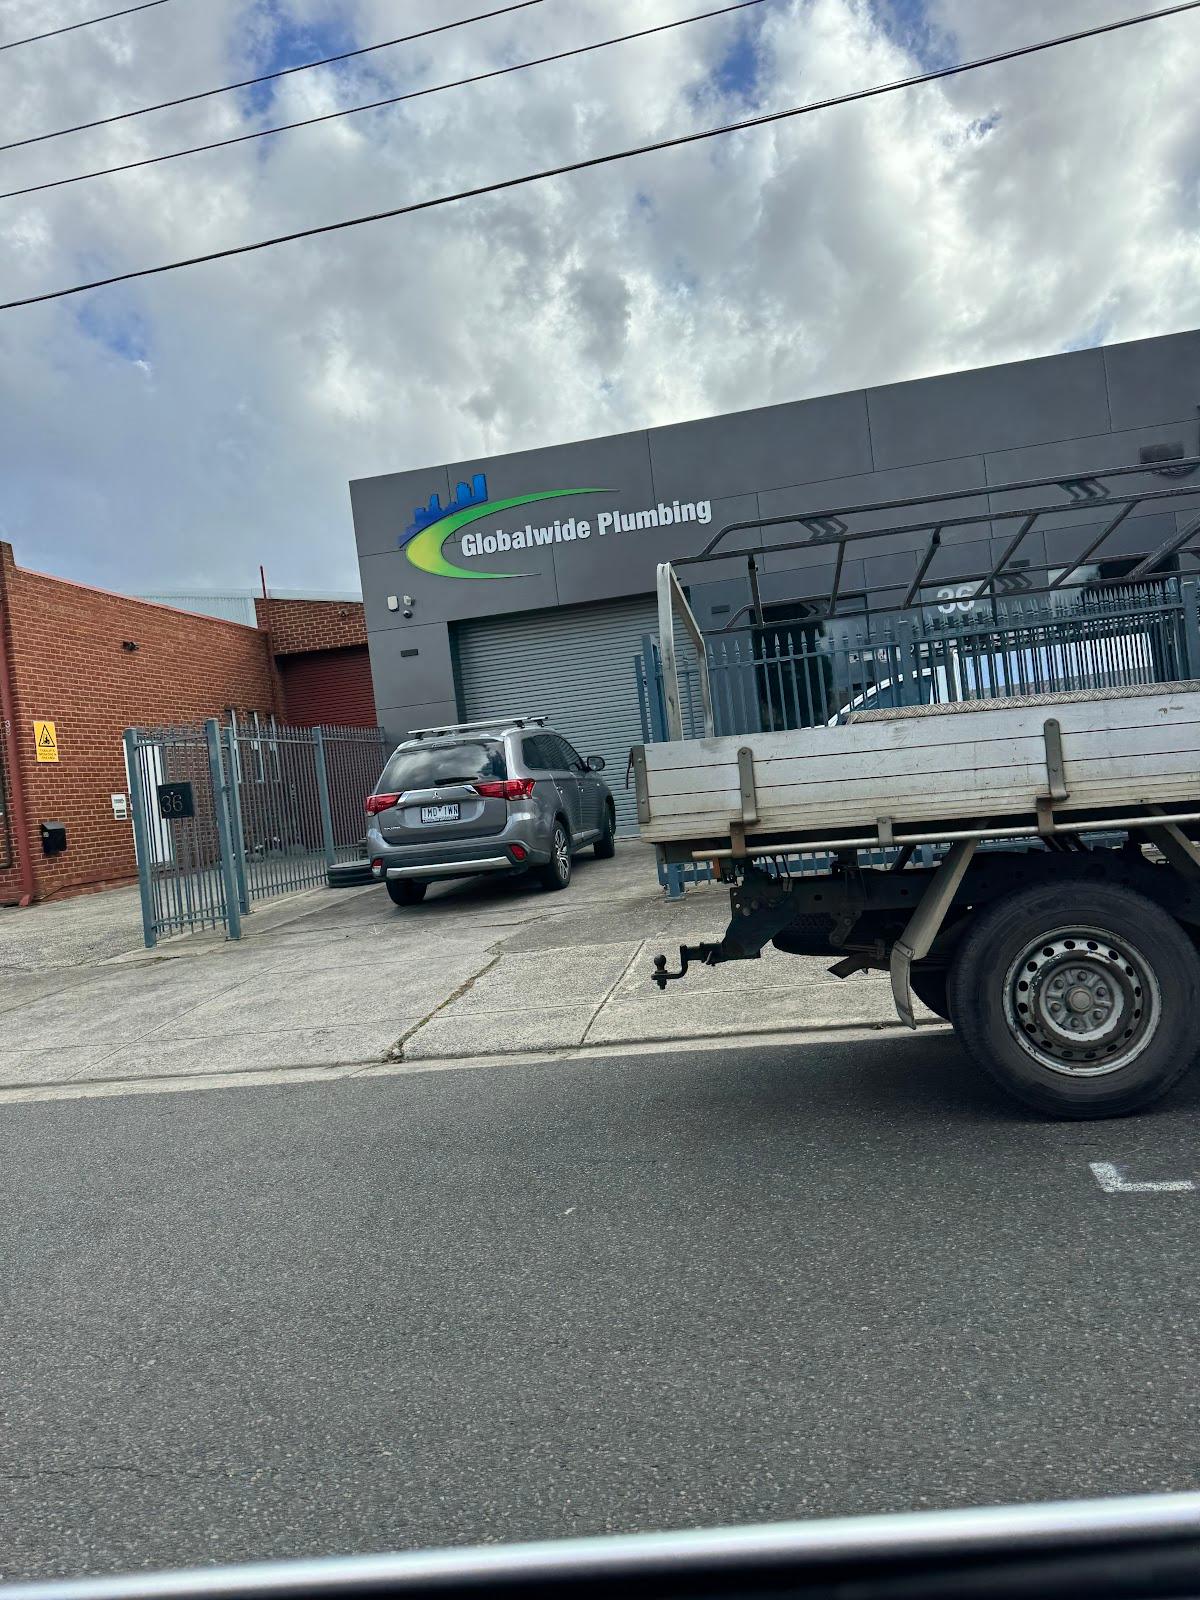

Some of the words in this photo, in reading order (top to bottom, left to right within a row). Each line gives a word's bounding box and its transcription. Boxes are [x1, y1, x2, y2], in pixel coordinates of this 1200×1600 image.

[461, 517, 591, 557] Globalwide
[597, 500, 712, 536] Plumbing
[937, 586, 975, 614] 36
[162, 795, 182, 812] 36
